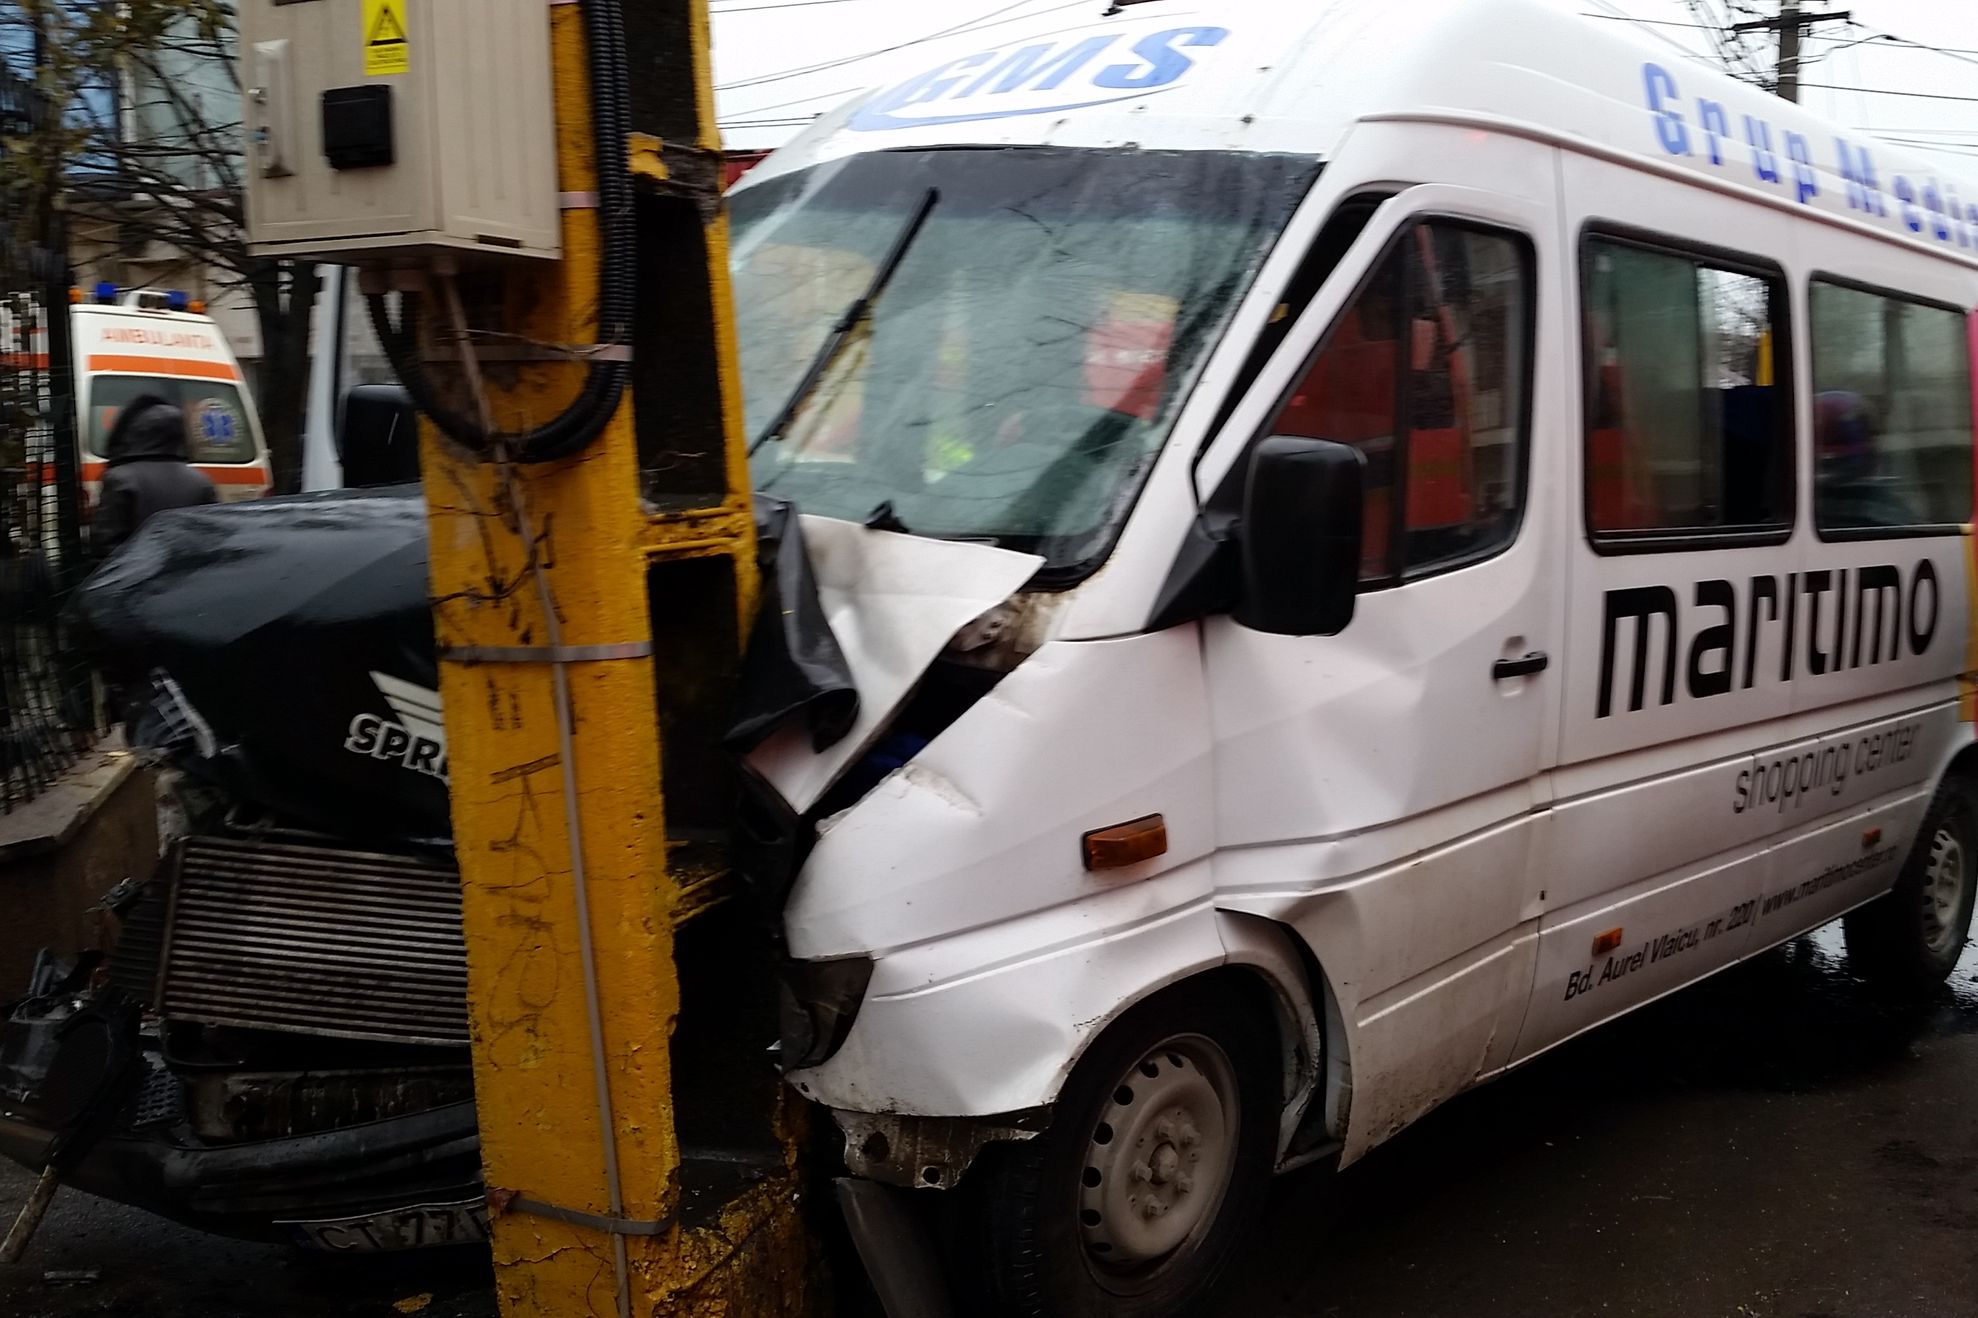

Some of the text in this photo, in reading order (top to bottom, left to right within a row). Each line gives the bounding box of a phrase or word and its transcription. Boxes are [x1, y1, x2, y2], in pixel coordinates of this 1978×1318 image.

[871, 26, 1231, 116] GMS
[1641, 62, 1820, 203] Grup
[1595, 558, 1939, 719] maritimo
[1733, 723, 1922, 814] shopping center
[1563, 964, 1593, 1001] Bd.
[1597, 942, 1650, 986] Aurel
[1650, 928, 1700, 963] Vlaicu,
[1703, 918, 1724, 941] nr.
